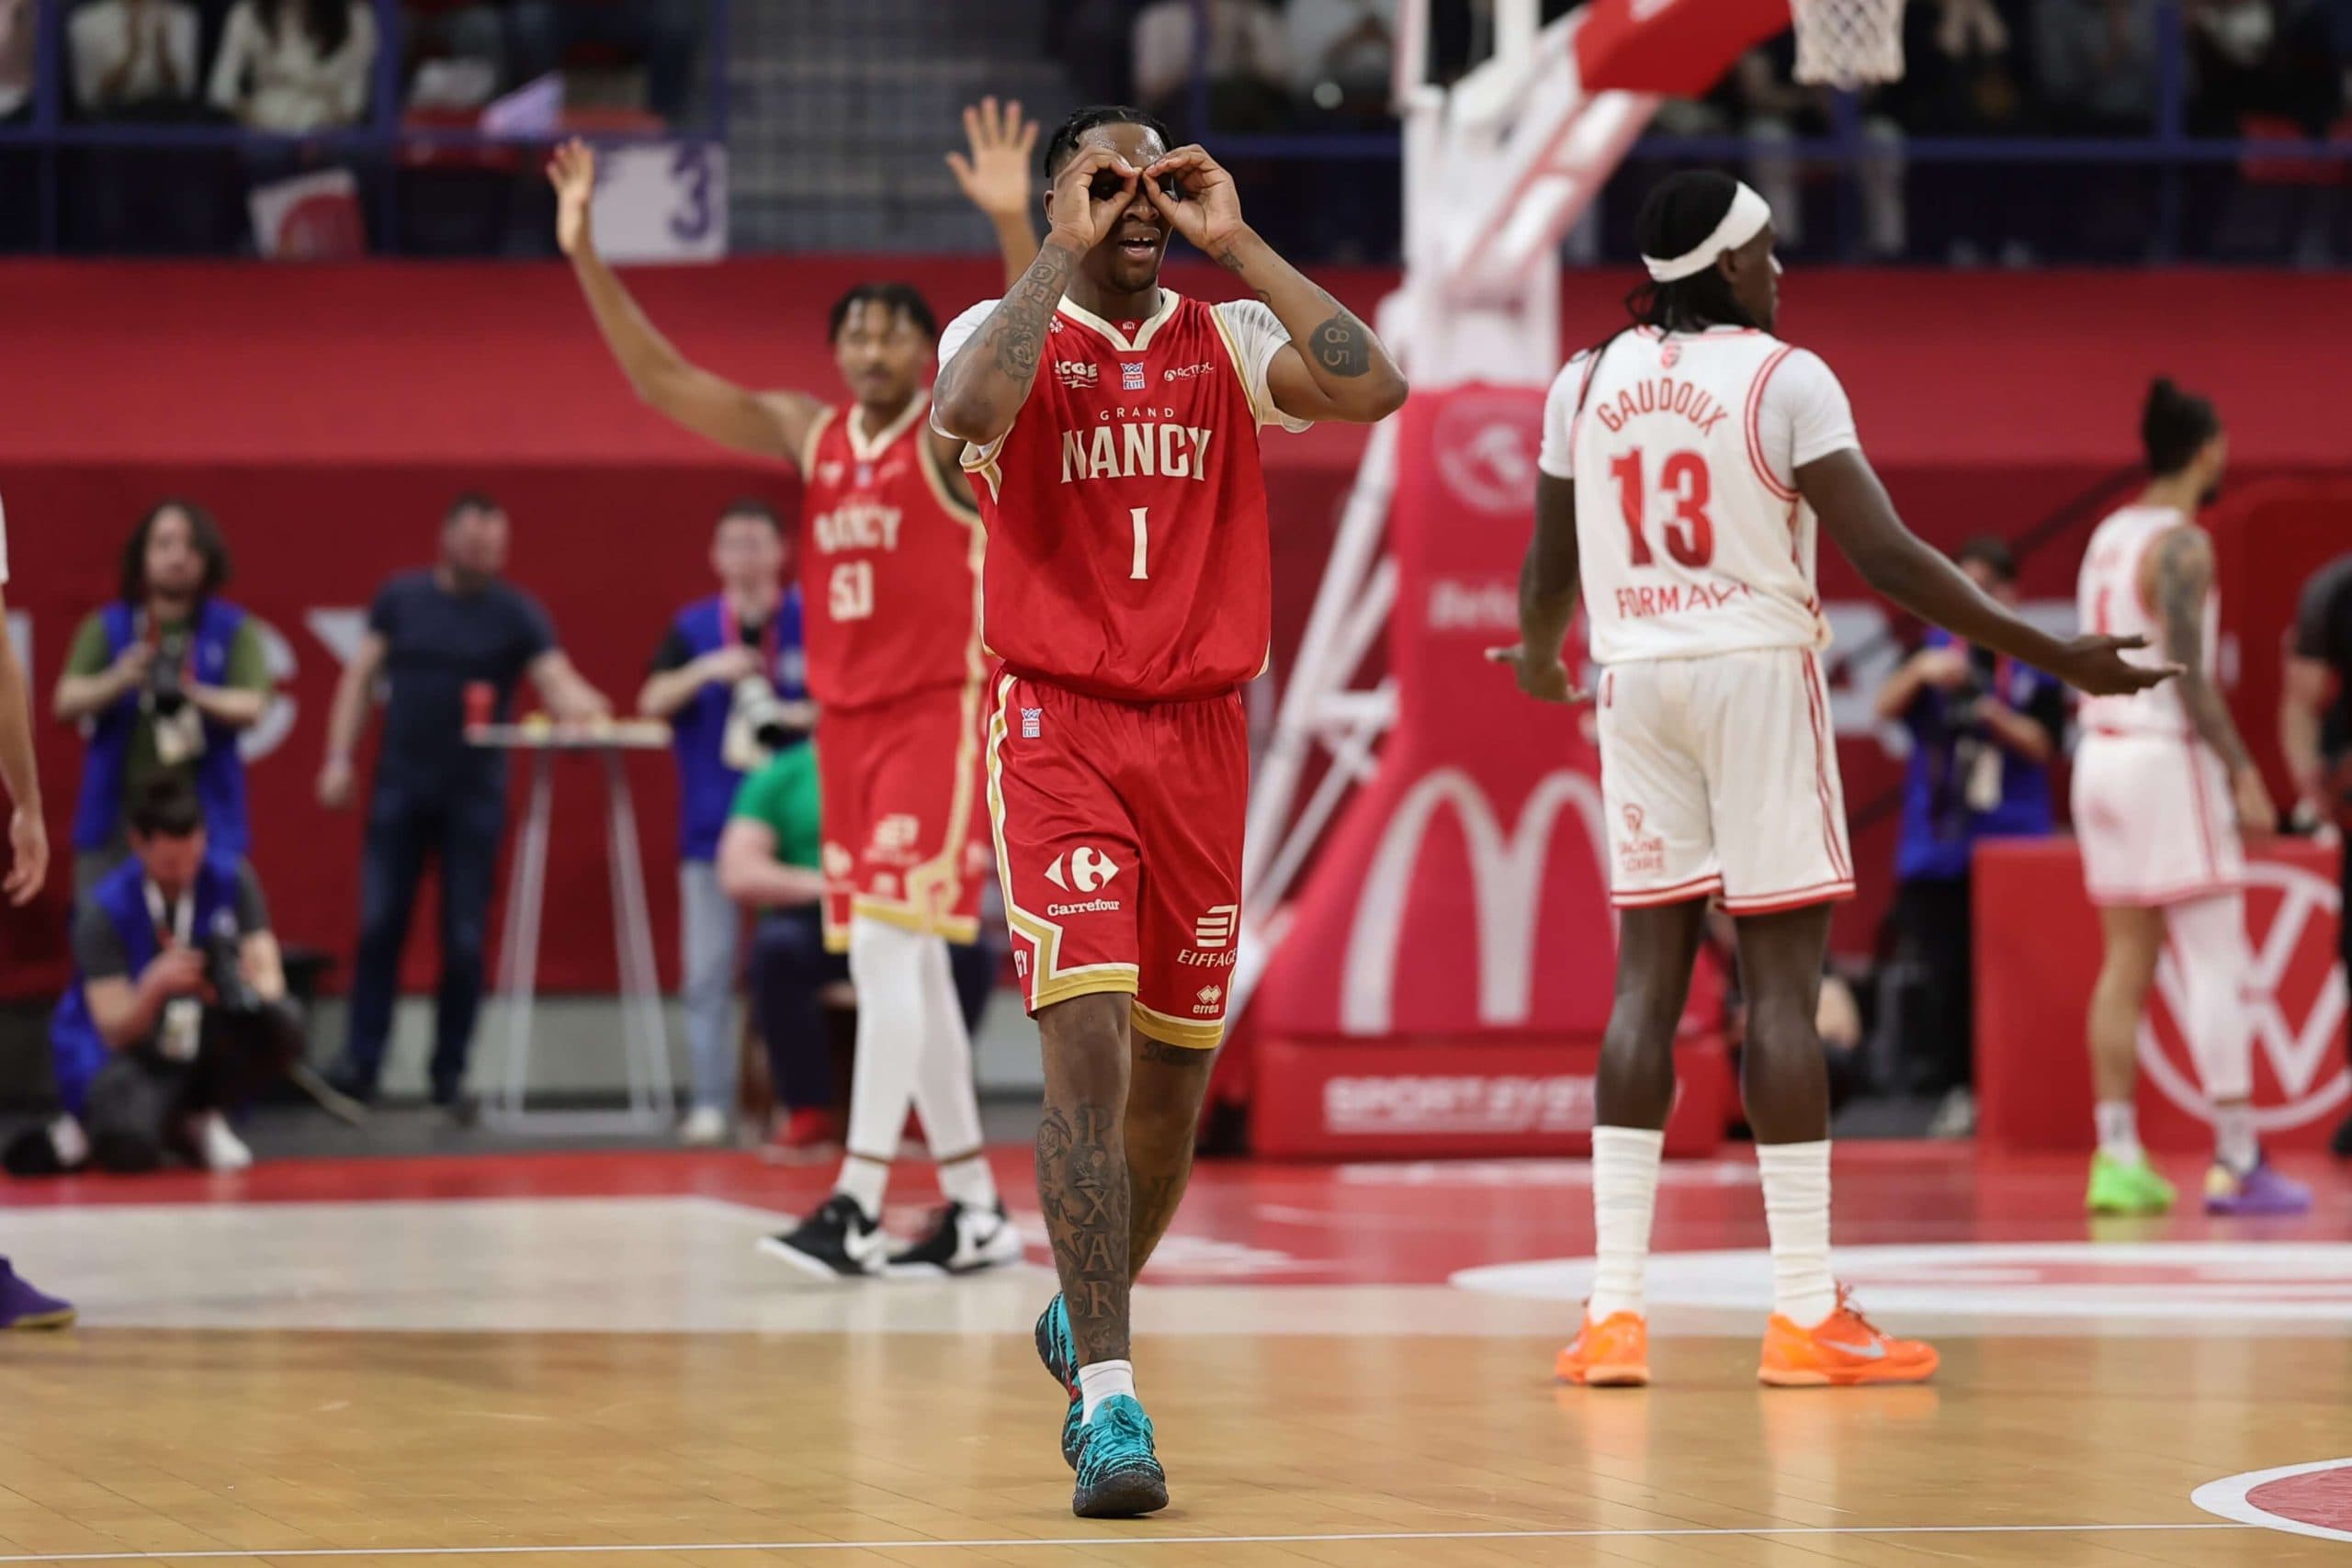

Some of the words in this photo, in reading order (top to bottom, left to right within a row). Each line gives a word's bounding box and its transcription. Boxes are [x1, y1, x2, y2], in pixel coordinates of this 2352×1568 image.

[1100, 407, 1175, 421] GRAND
[1597, 378, 1728, 437] GAUDOUX
[1060, 423, 1213, 484] NANCY
[1611, 446, 1714, 568] 13
[1129, 507, 1149, 581] 1
[1047, 898, 1120, 917] Carrefour
